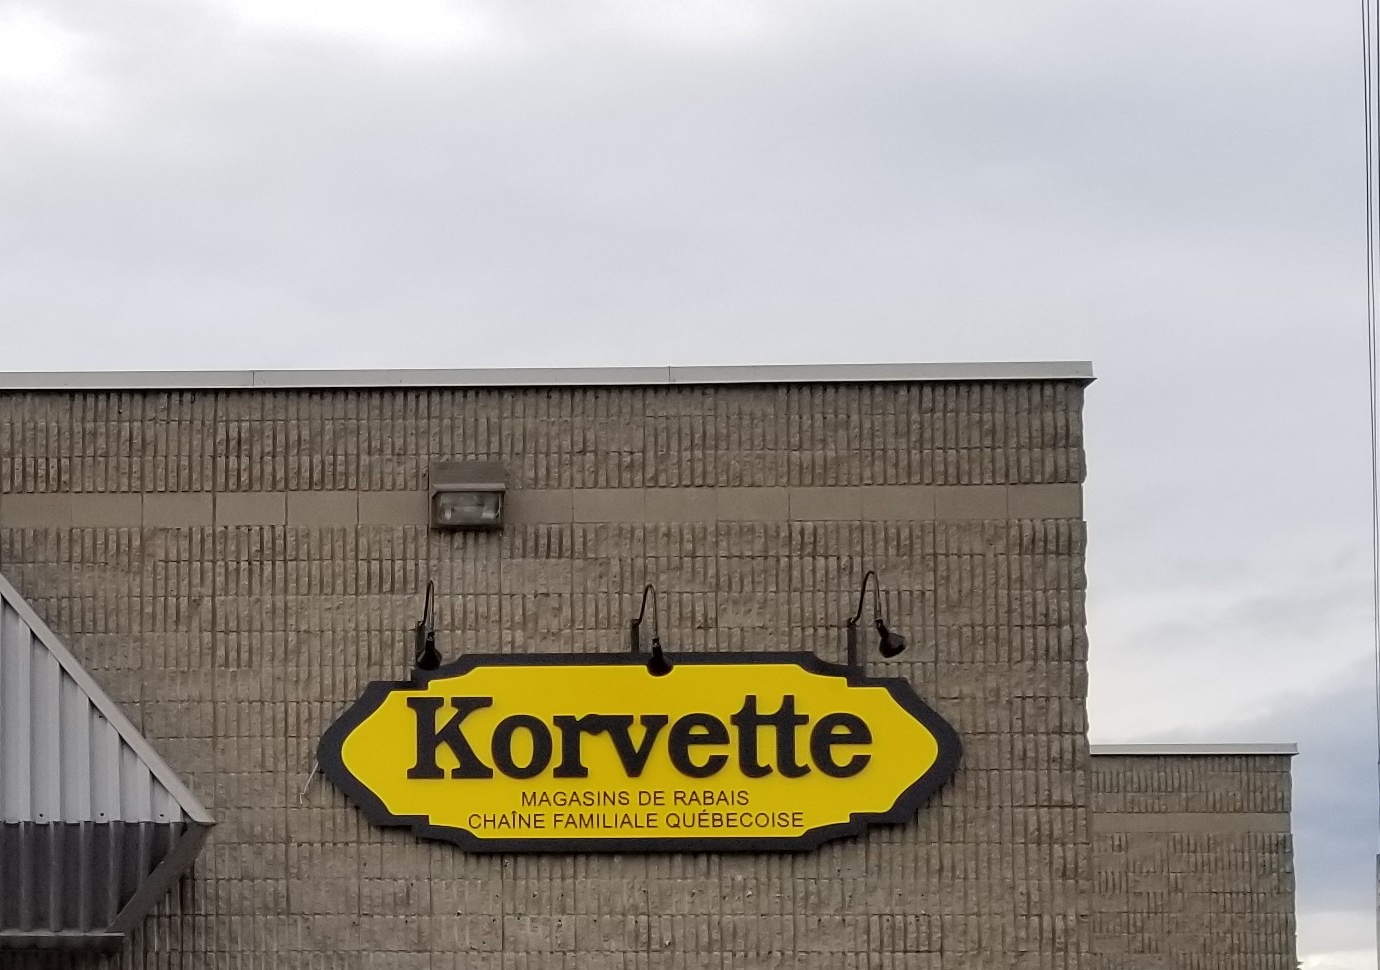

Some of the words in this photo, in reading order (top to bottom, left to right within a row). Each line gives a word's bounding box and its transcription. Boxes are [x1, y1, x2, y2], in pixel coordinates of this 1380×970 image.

[406, 694, 873, 780] Korvette
[521, 790, 630, 807] MAGASINS
[638, 790, 666, 806] DE
[673, 790, 750, 806] RABAIS
[468, 810, 546, 829] CHAÎNE
[553, 812, 658, 829] FAMILIALE
[666, 809, 804, 829] QUÉBECOISE
